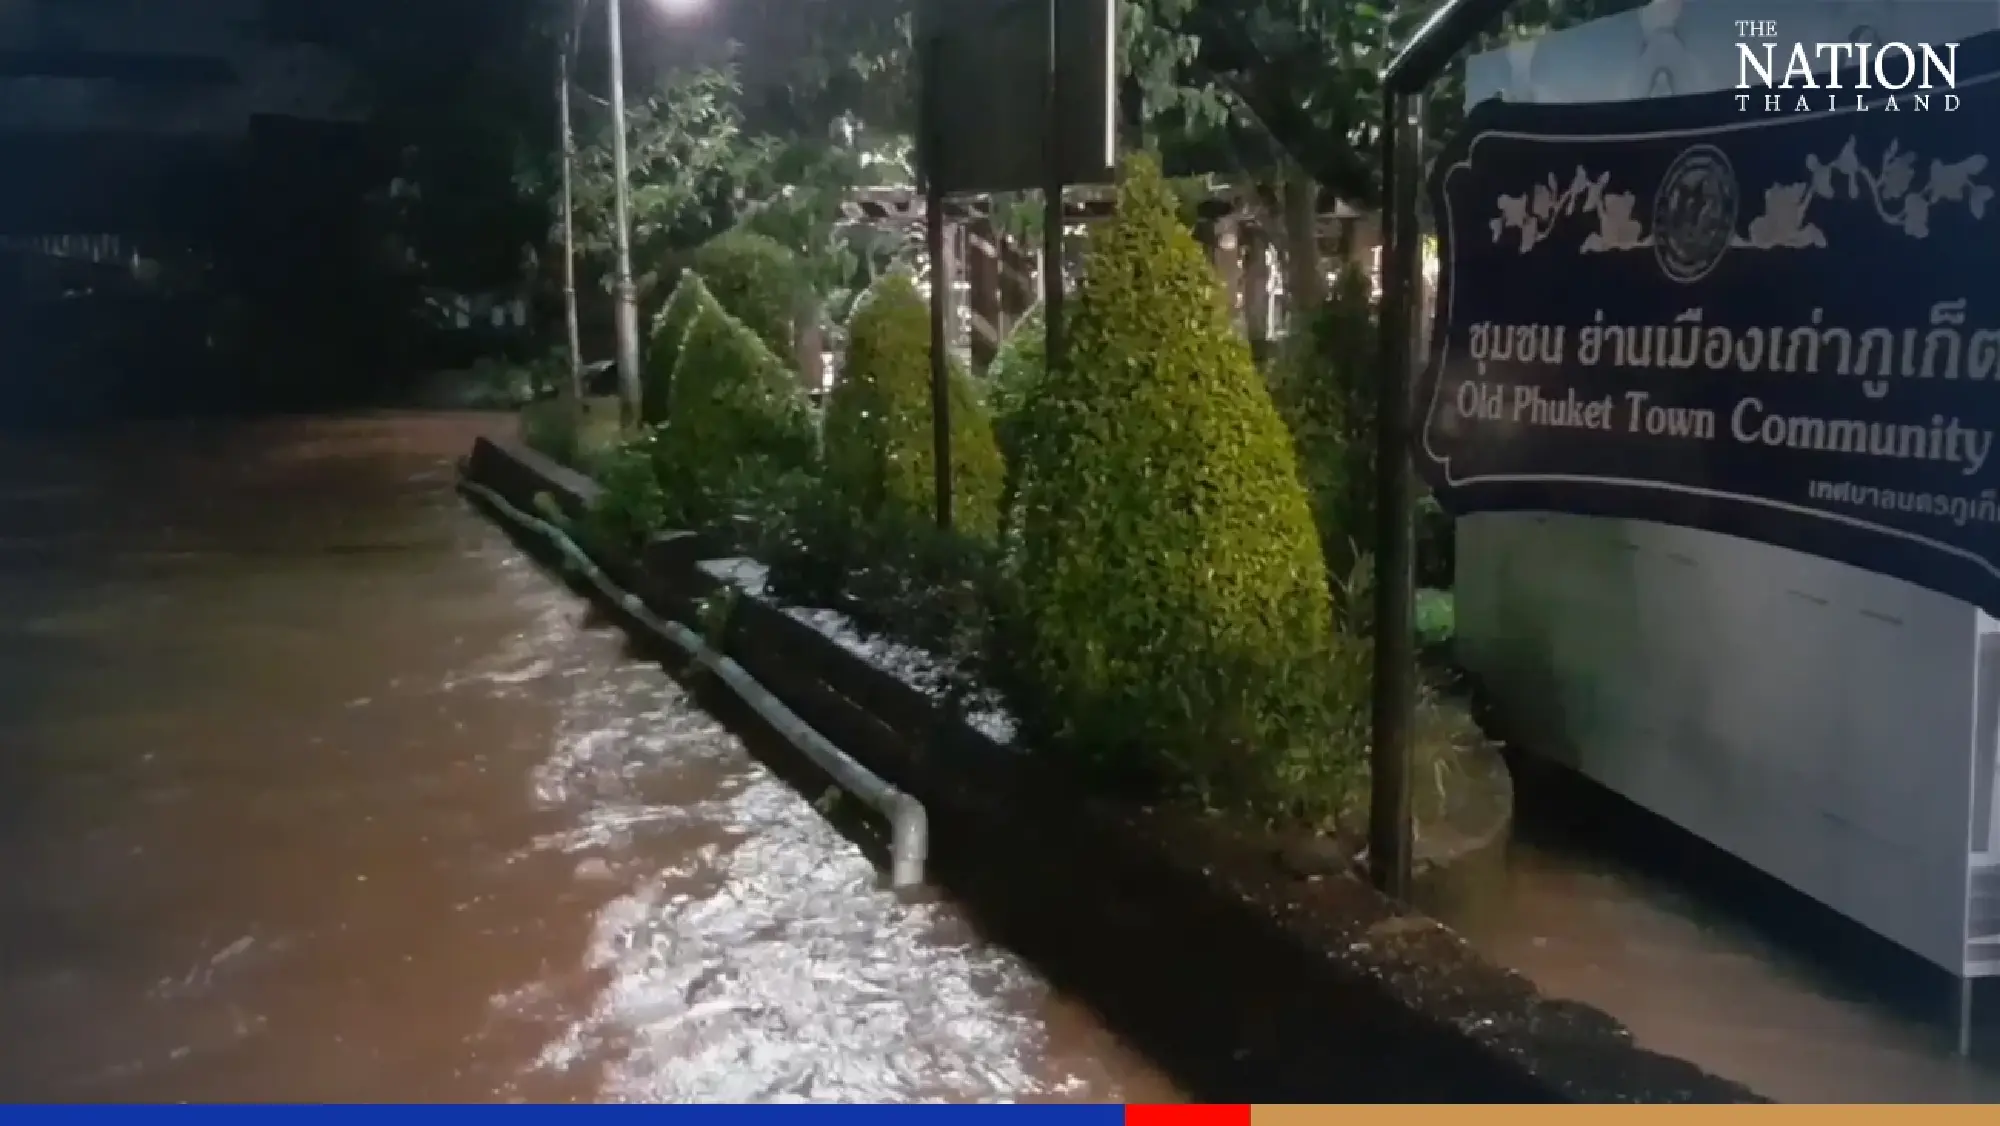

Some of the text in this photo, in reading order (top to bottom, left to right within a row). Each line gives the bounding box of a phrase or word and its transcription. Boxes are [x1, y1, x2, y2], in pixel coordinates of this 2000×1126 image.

[1468, 320, 1566, 375] ชุมชน
[1457, 380, 1994, 475] Old Phuket Town Community
